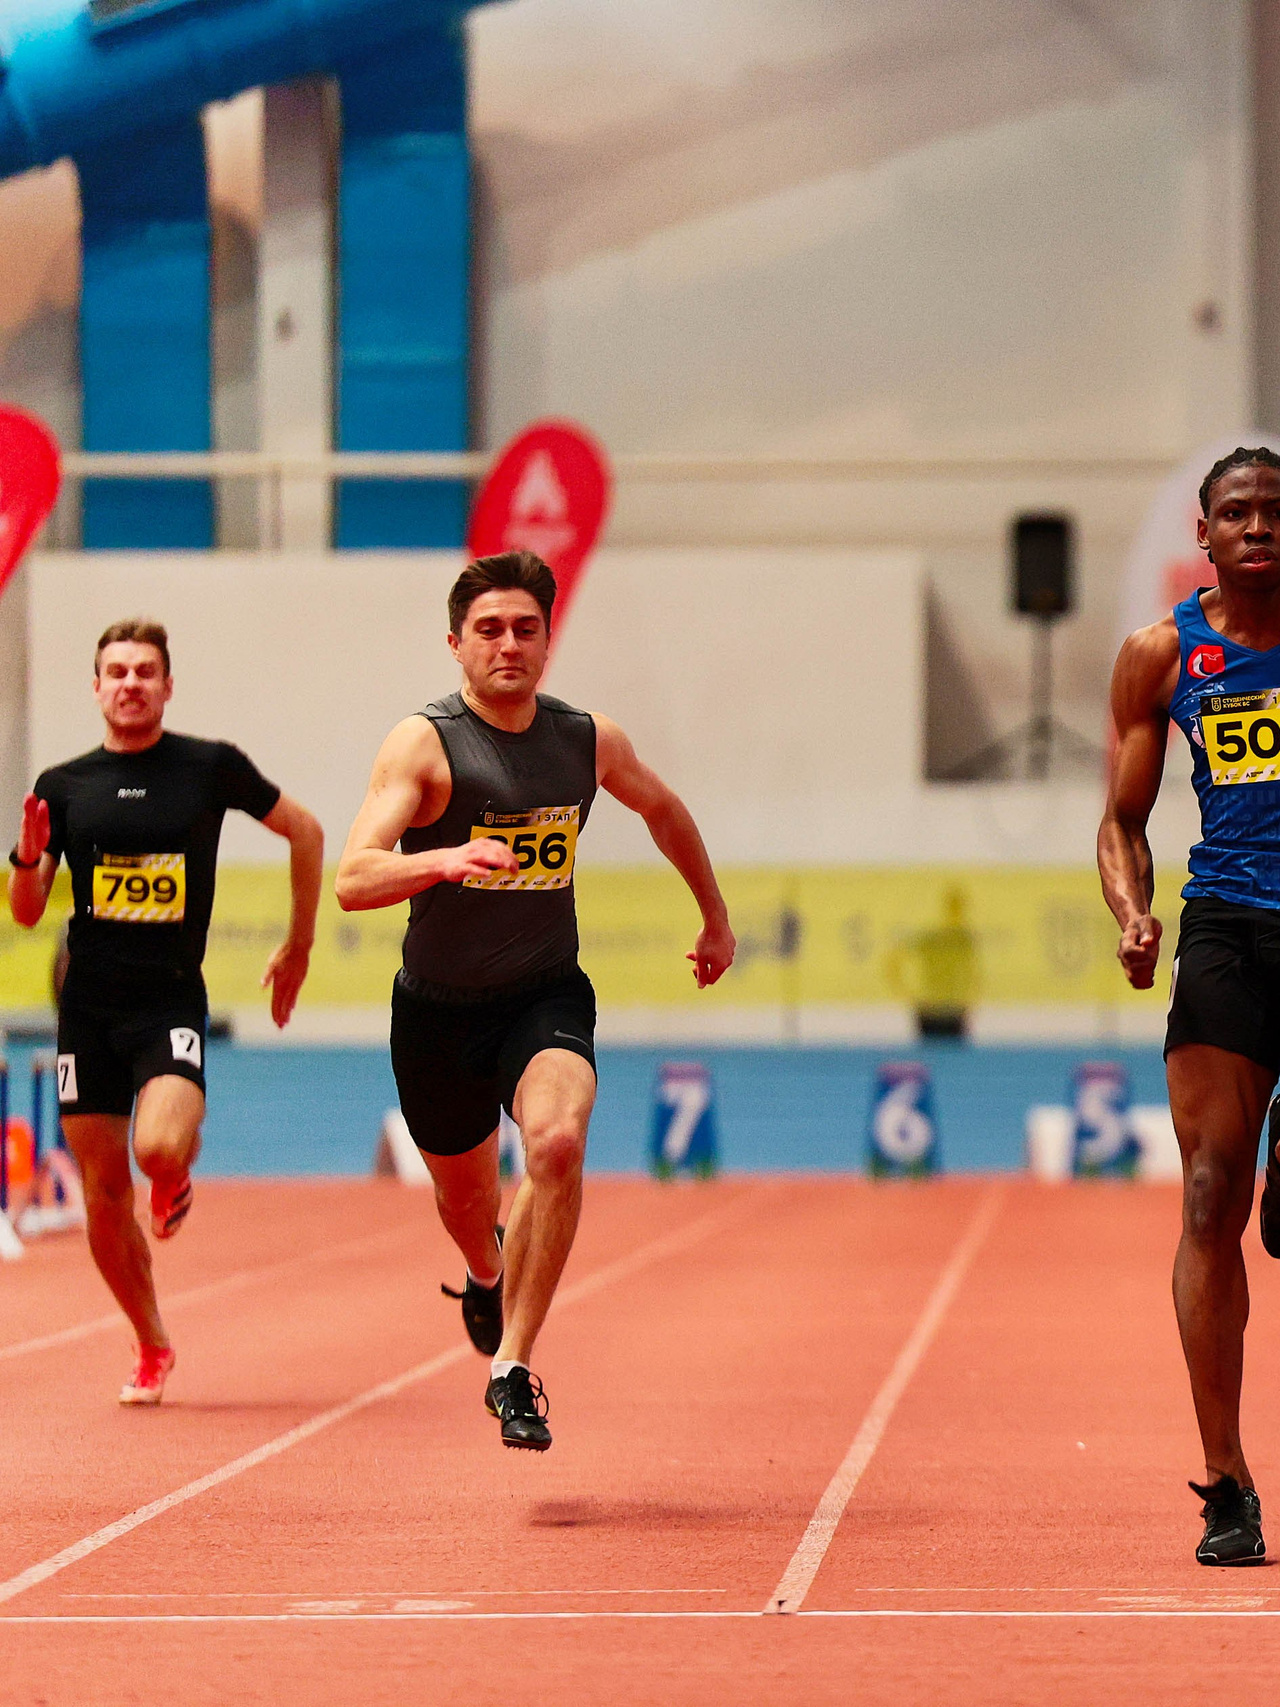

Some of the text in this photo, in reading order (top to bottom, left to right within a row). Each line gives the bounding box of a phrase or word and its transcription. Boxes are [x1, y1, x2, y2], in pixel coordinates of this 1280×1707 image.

[1273, 696, 1278, 704] 1
[544, 813, 570, 822] ЭТАП
[486, 832, 568, 870] 56
[102, 873, 177, 904] 799
[178, 1032, 194, 1053] 7
[60, 1062, 69, 1092] 7
[662, 1080, 709, 1162] 7
[873, 1080, 931, 1163] 6
[1075, 1080, 1125, 1163] 5
